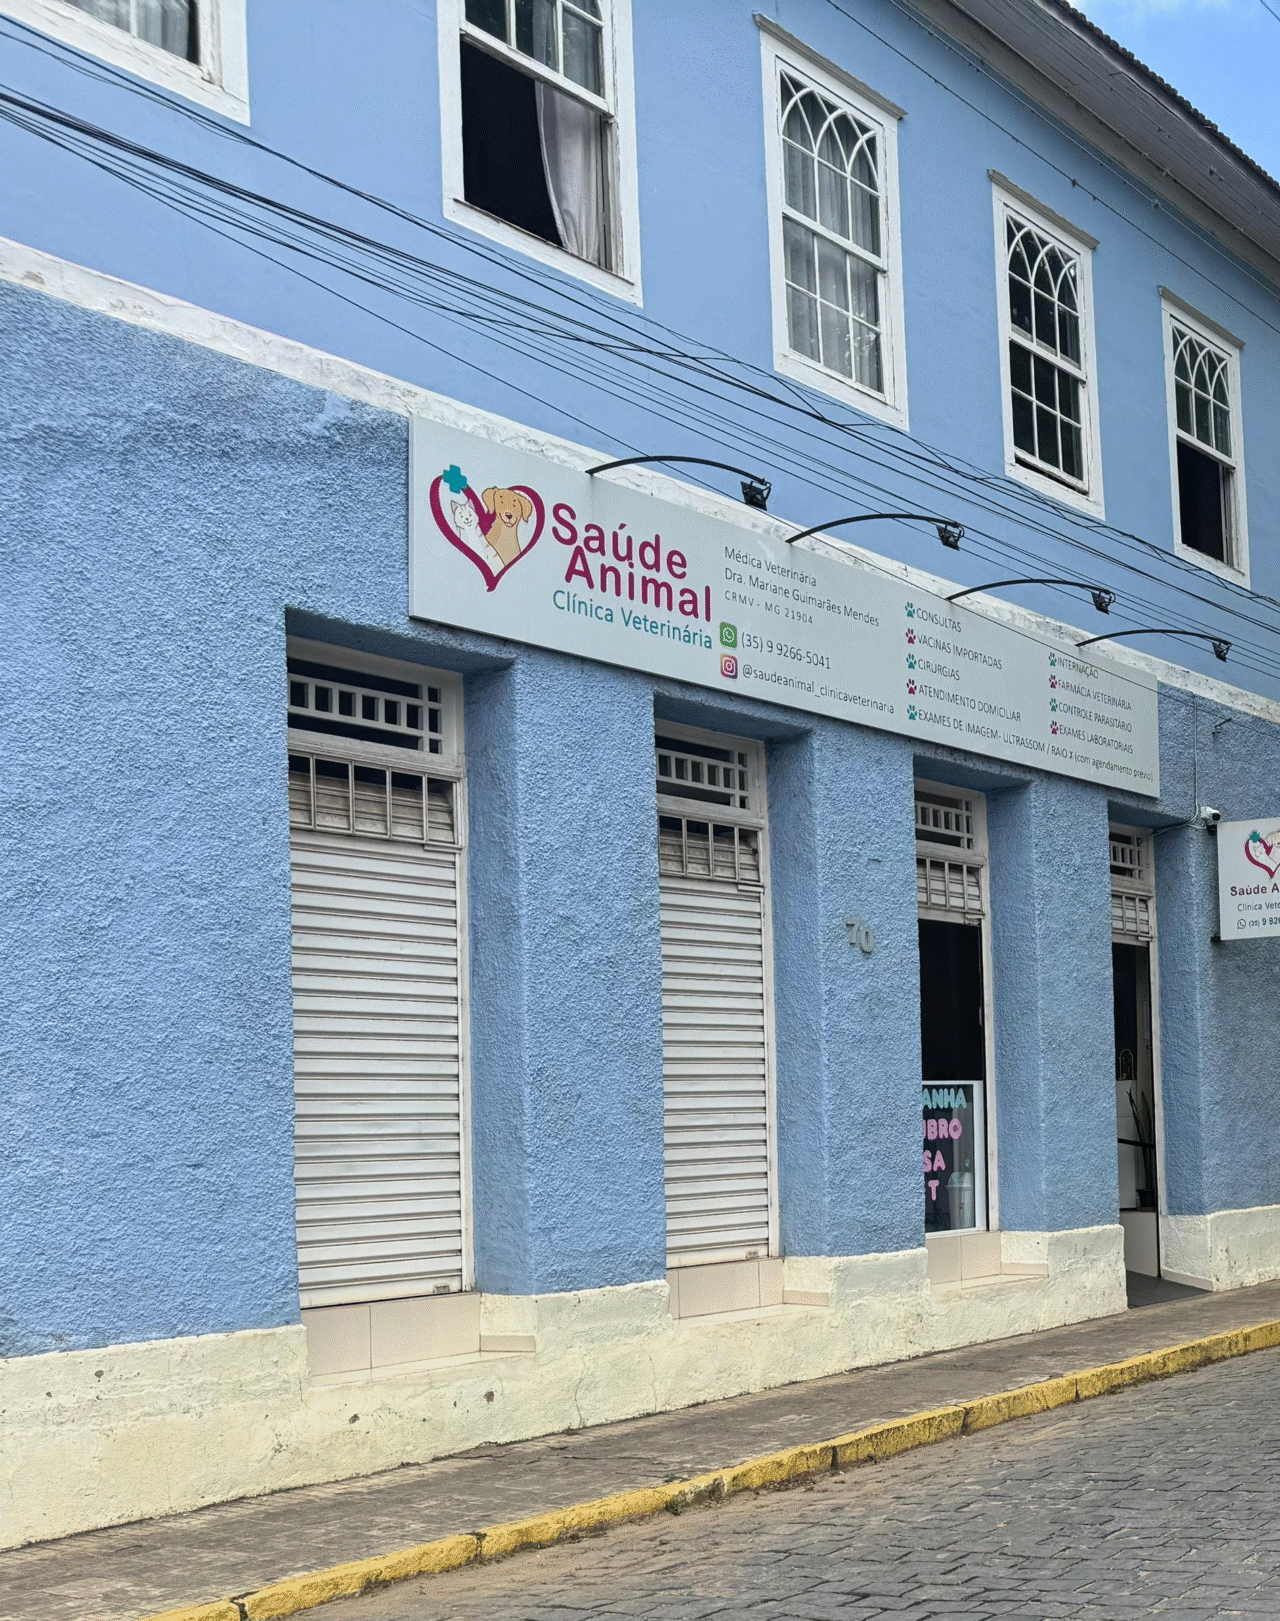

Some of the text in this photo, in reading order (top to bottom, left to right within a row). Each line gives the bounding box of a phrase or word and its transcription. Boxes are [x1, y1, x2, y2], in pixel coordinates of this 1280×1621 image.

[552, 503, 687, 579] Saúde
[565, 545, 711, 622] Animal
[724, 546, 817, 586] Médica Veterinária
[724, 590, 755, 607] CRMV
[764, 602, 781, 615] MG
[784, 607, 813, 625] 21904
[725, 567, 880, 627] Dra. Mariane Guimarães Mendes
[552, 589, 713, 649] Clínica Veterinária
[917, 608, 962, 632] CONSULTAS
[741, 631, 831, 669] (35) 9 9266-5041
[917, 632, 1003, 670] VACINAS IMPORTADAS
[1057, 657, 1099, 679] INTERNAÇÃO
[917, 658, 960, 681] CIRURGIAS
[742, 663, 894, 714] @saudeanimal_clinicaveterinaria
[918, 684, 1021, 722] ATENDIMENTO DOMICILIAR
[1058, 679, 1132, 711] FARMÁCIA VETERINÁRIA
[1058, 702, 1092, 721] CONTROLE
[918, 709, 951, 728] EXAMES
[953, 718, 963, 731] DE
[1002, 732, 1045, 753] ULTRASSOM
[1051, 745, 1068, 759] RAIO
[1069, 750, 1074, 759] X
[1074, 750, 1091, 764] (com
[1091, 758, 1133, 776] agendamento
[1059, 724, 1134, 754] EXAMES LABORATORIAIS
[1230, 884, 1267, 896] Saúde
[1237, 902, 1263, 911] Clínica
[1261, 917, 1267, 926] 9
